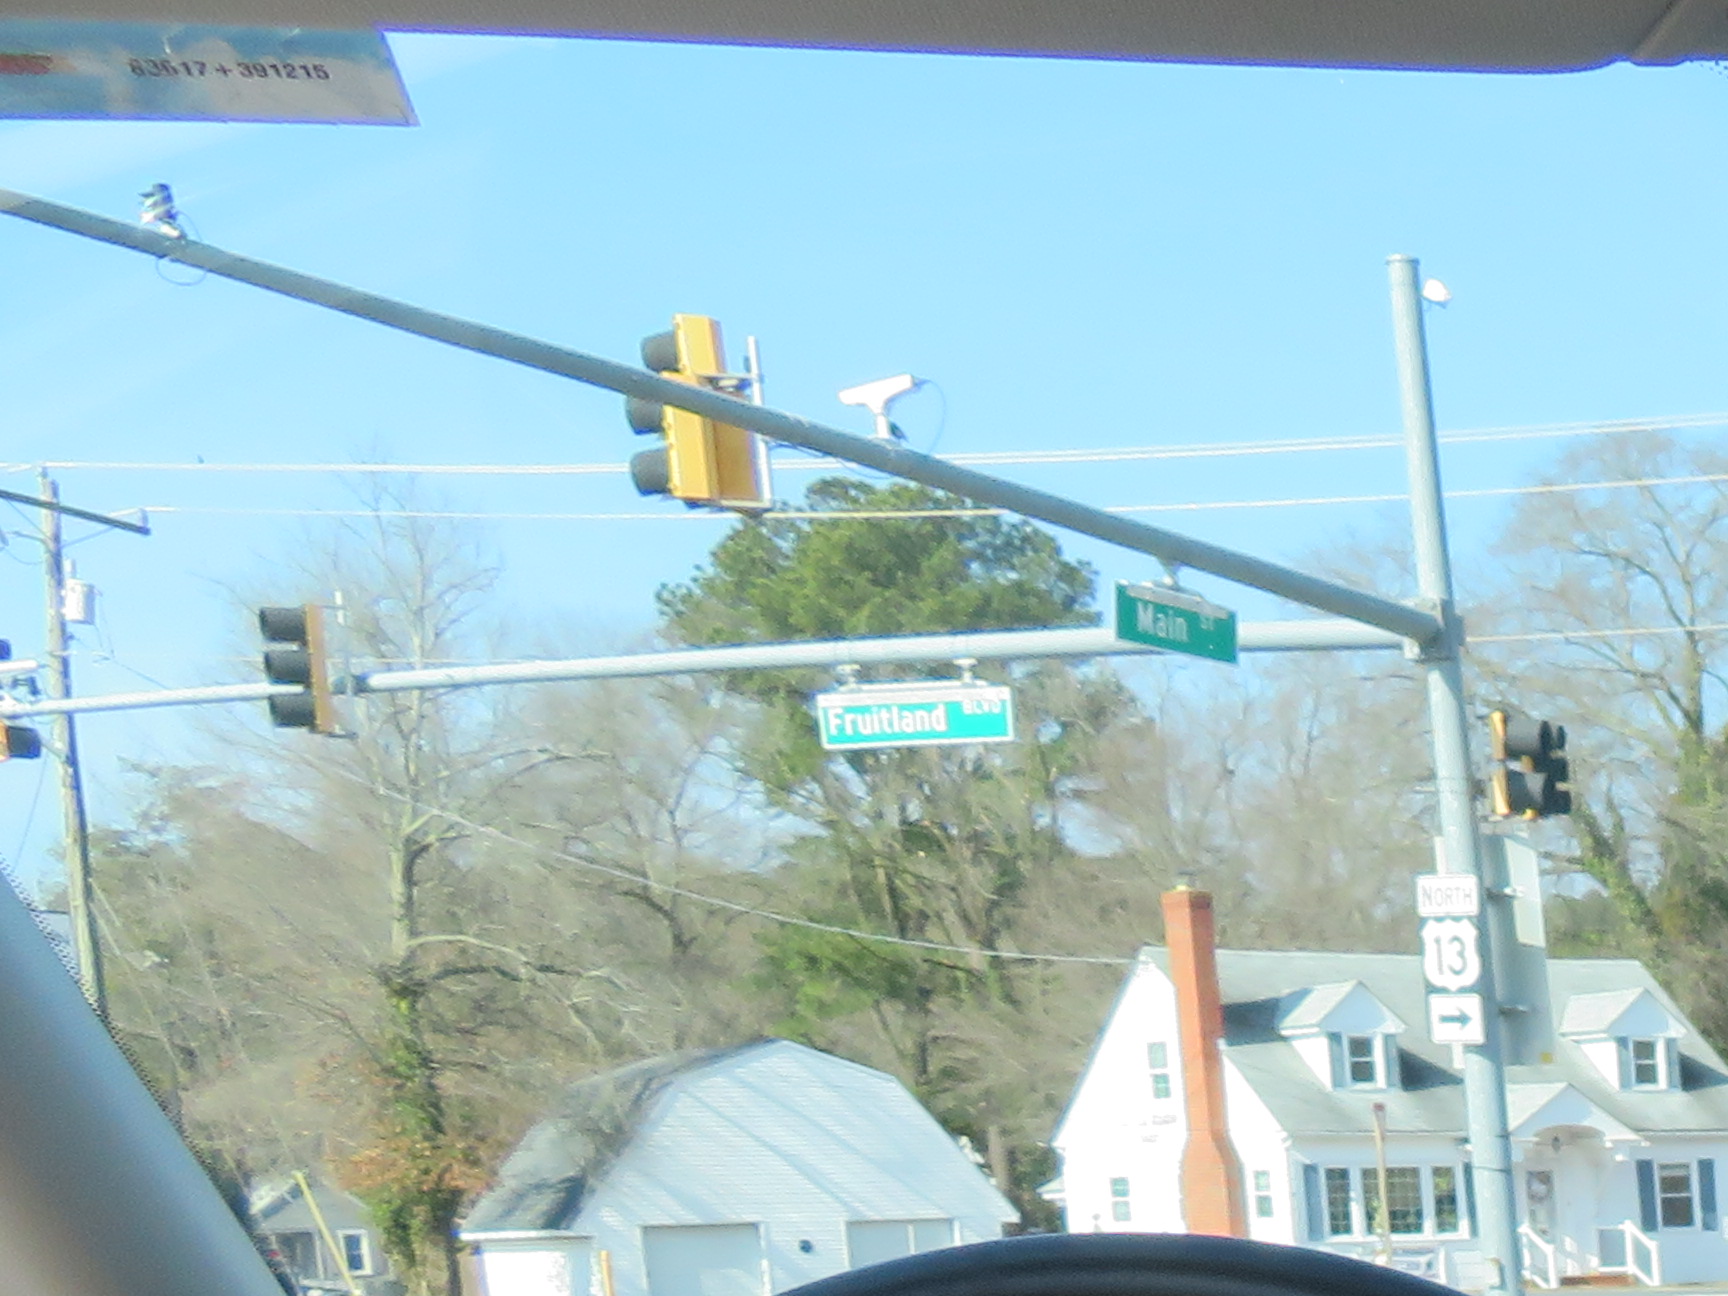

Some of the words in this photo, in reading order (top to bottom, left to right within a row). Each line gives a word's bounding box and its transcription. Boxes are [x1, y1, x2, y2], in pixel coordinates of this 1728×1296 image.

[1136, 601, 1188, 642] Main
[828, 704, 948, 736] Fruitland
[1421, 885, 1473, 907] NORTH
[1434, 935, 1468, 976] 13
